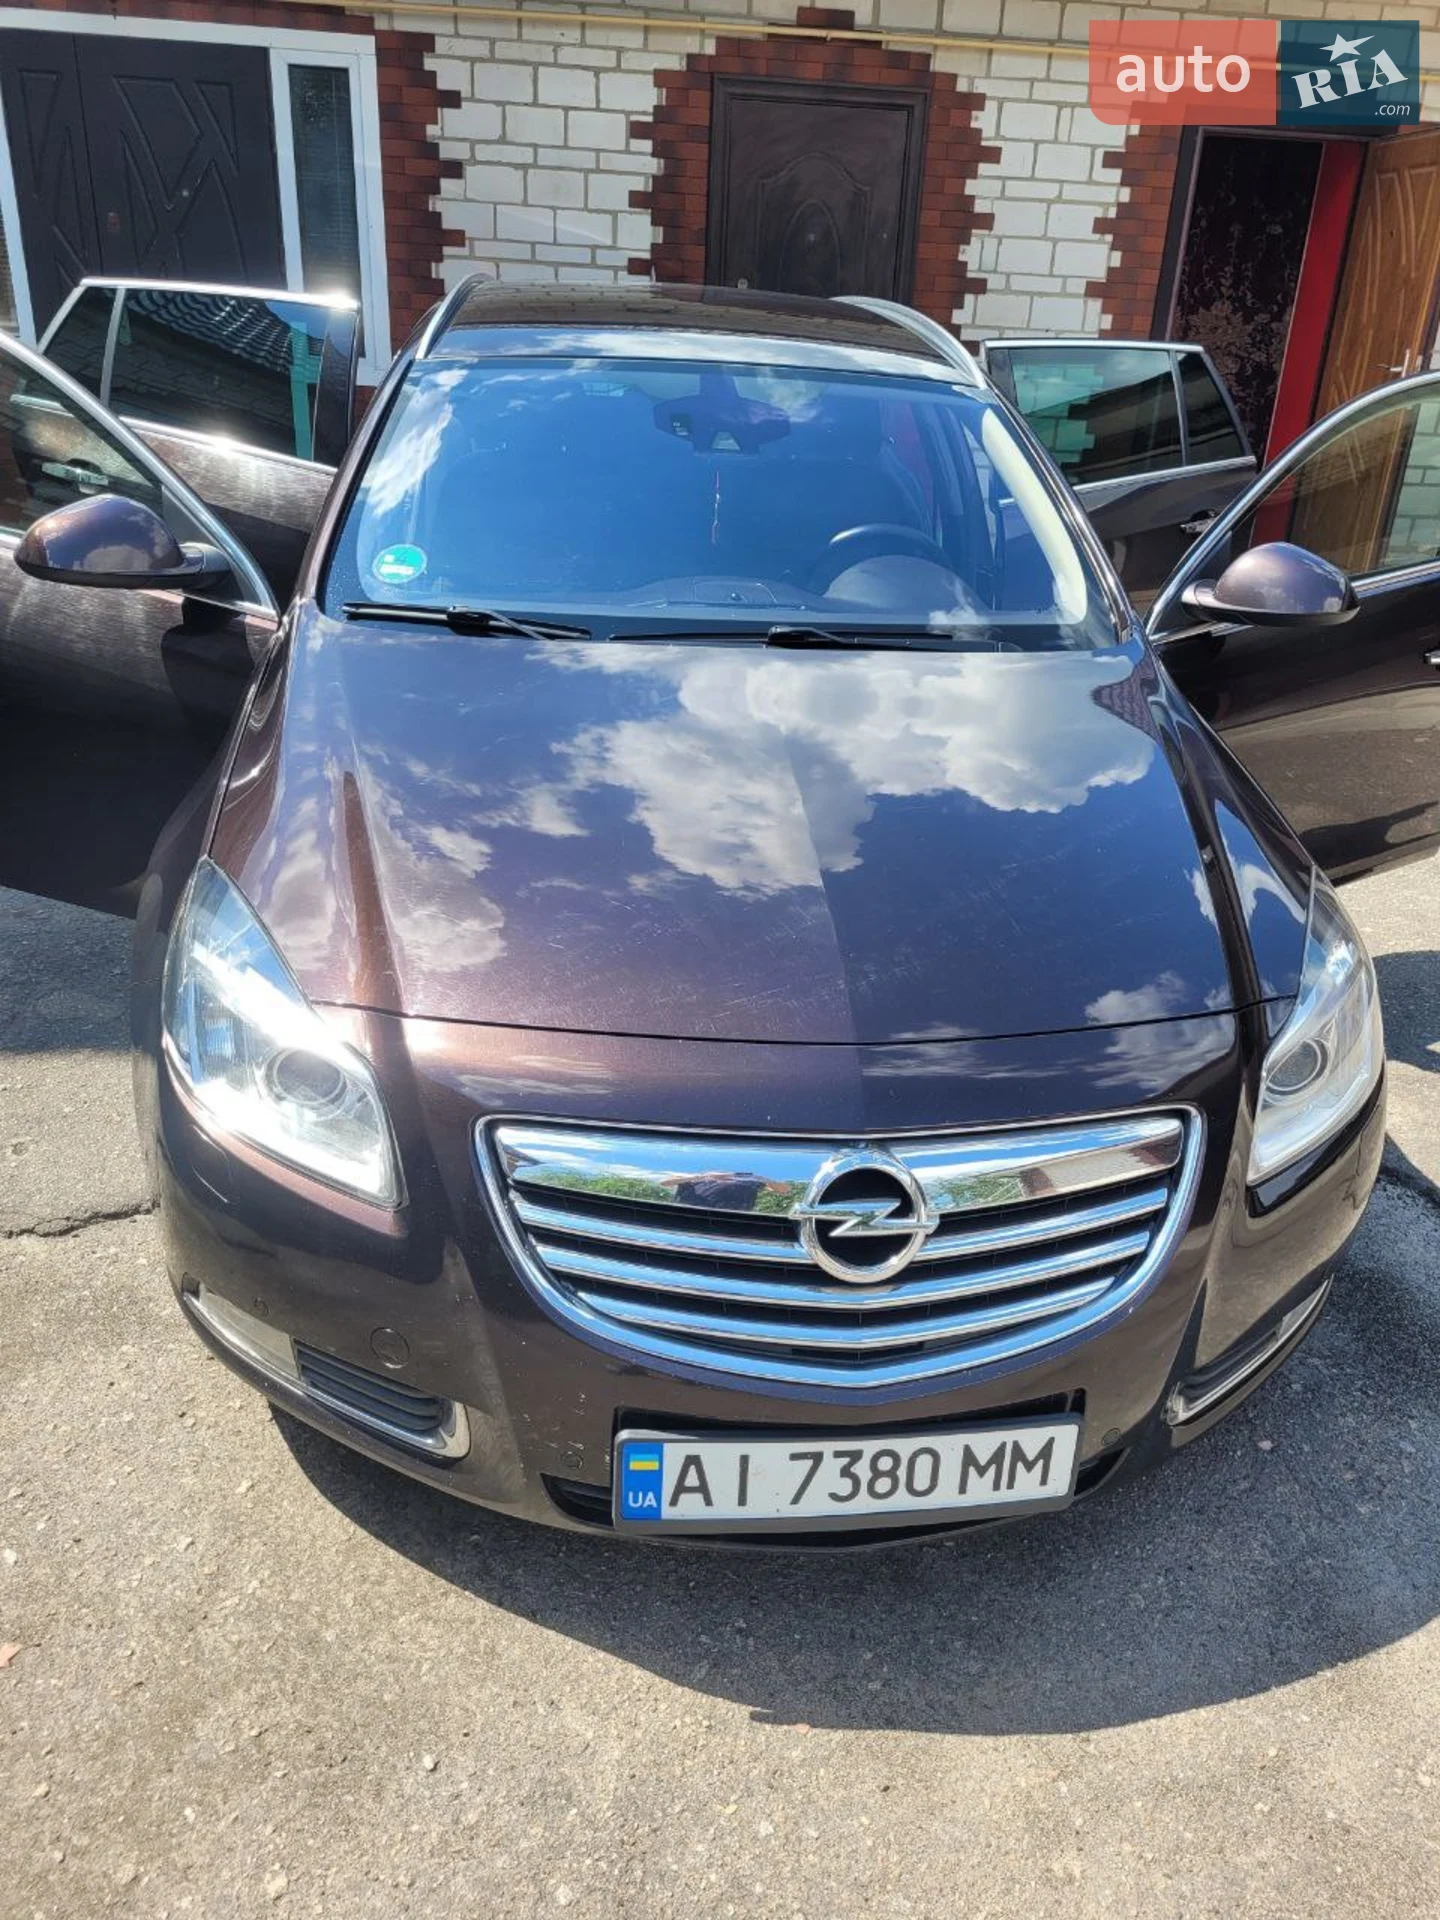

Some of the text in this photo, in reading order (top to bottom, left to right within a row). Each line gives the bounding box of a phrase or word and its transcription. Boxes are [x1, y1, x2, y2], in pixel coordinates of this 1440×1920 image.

[788, 1447, 941, 1506] 7380
[958, 1436, 1056, 1495] MM
[629, 1492, 657, 1508] UA
